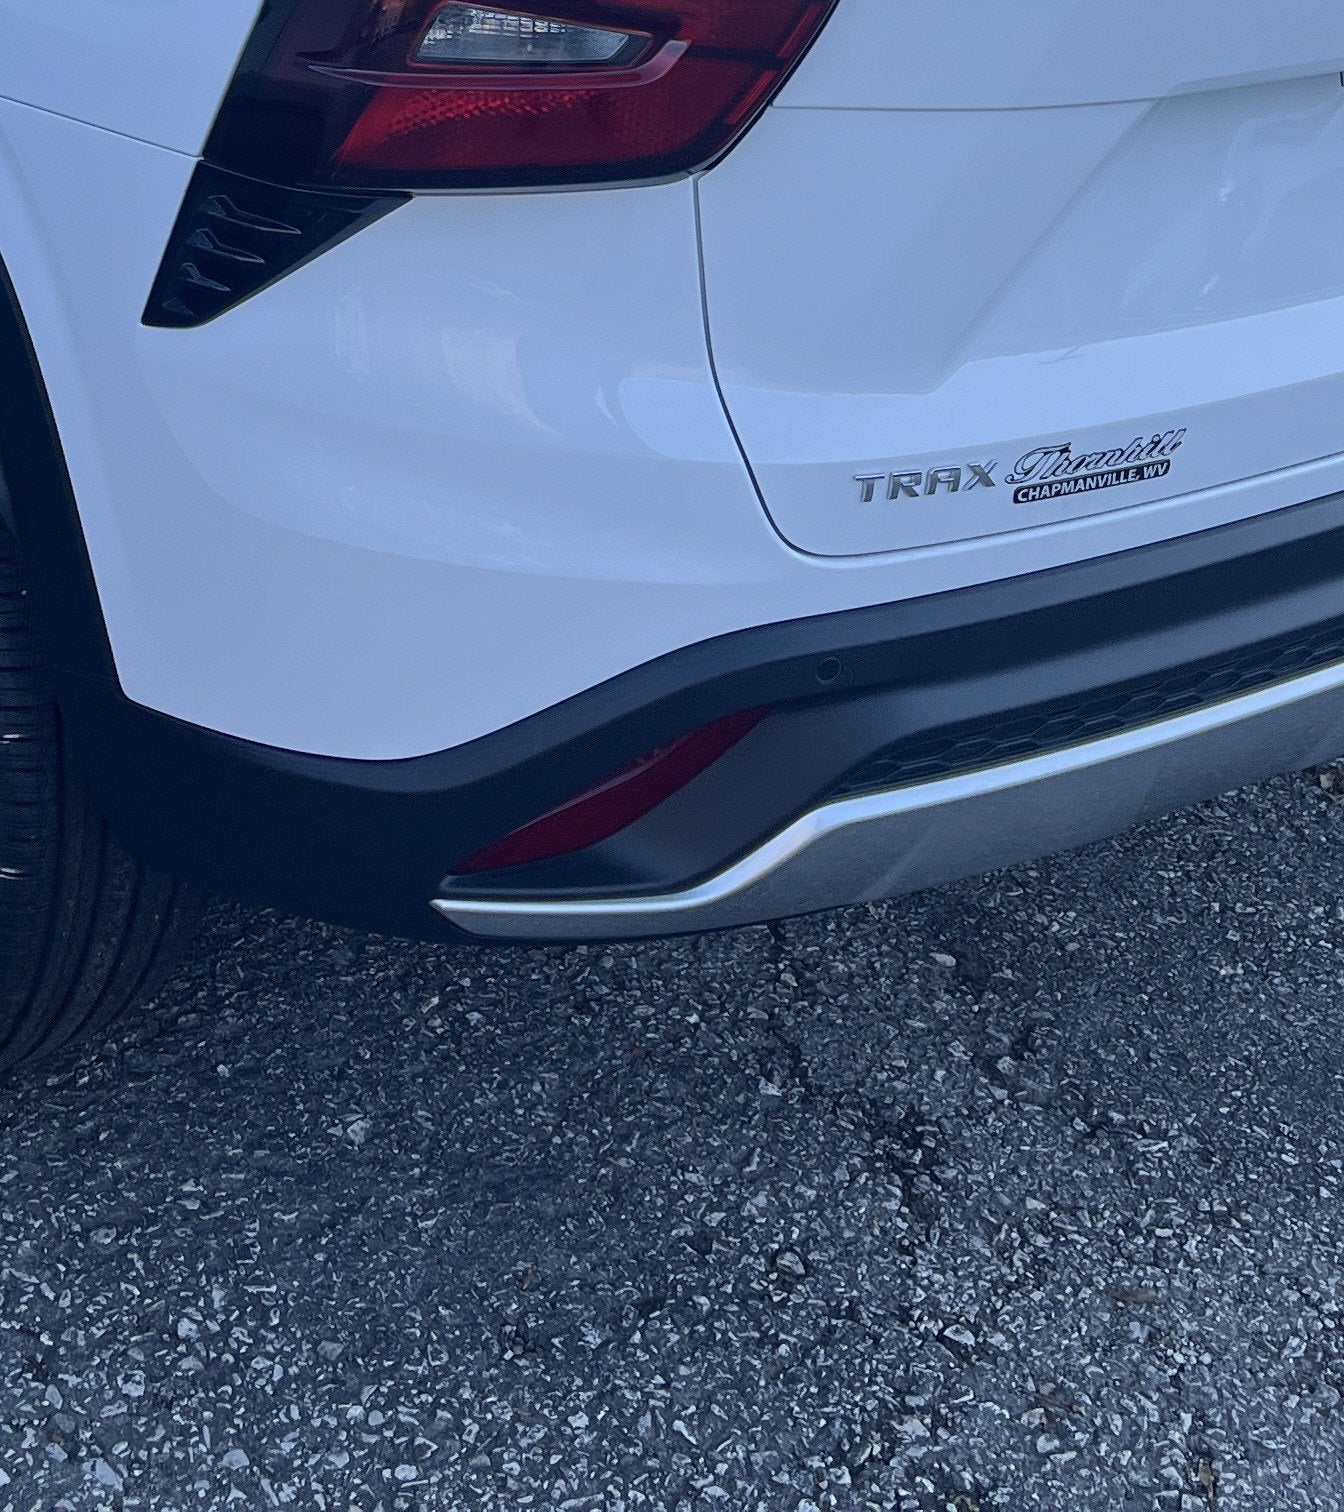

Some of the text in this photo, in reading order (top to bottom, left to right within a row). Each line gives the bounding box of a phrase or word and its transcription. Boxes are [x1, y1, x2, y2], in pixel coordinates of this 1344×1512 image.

[1005, 428, 1187, 484] Thornhill
[853, 459, 998, 502] TRAX
[1017, 461, 1168, 502] CHAPMANVILLE, WV
